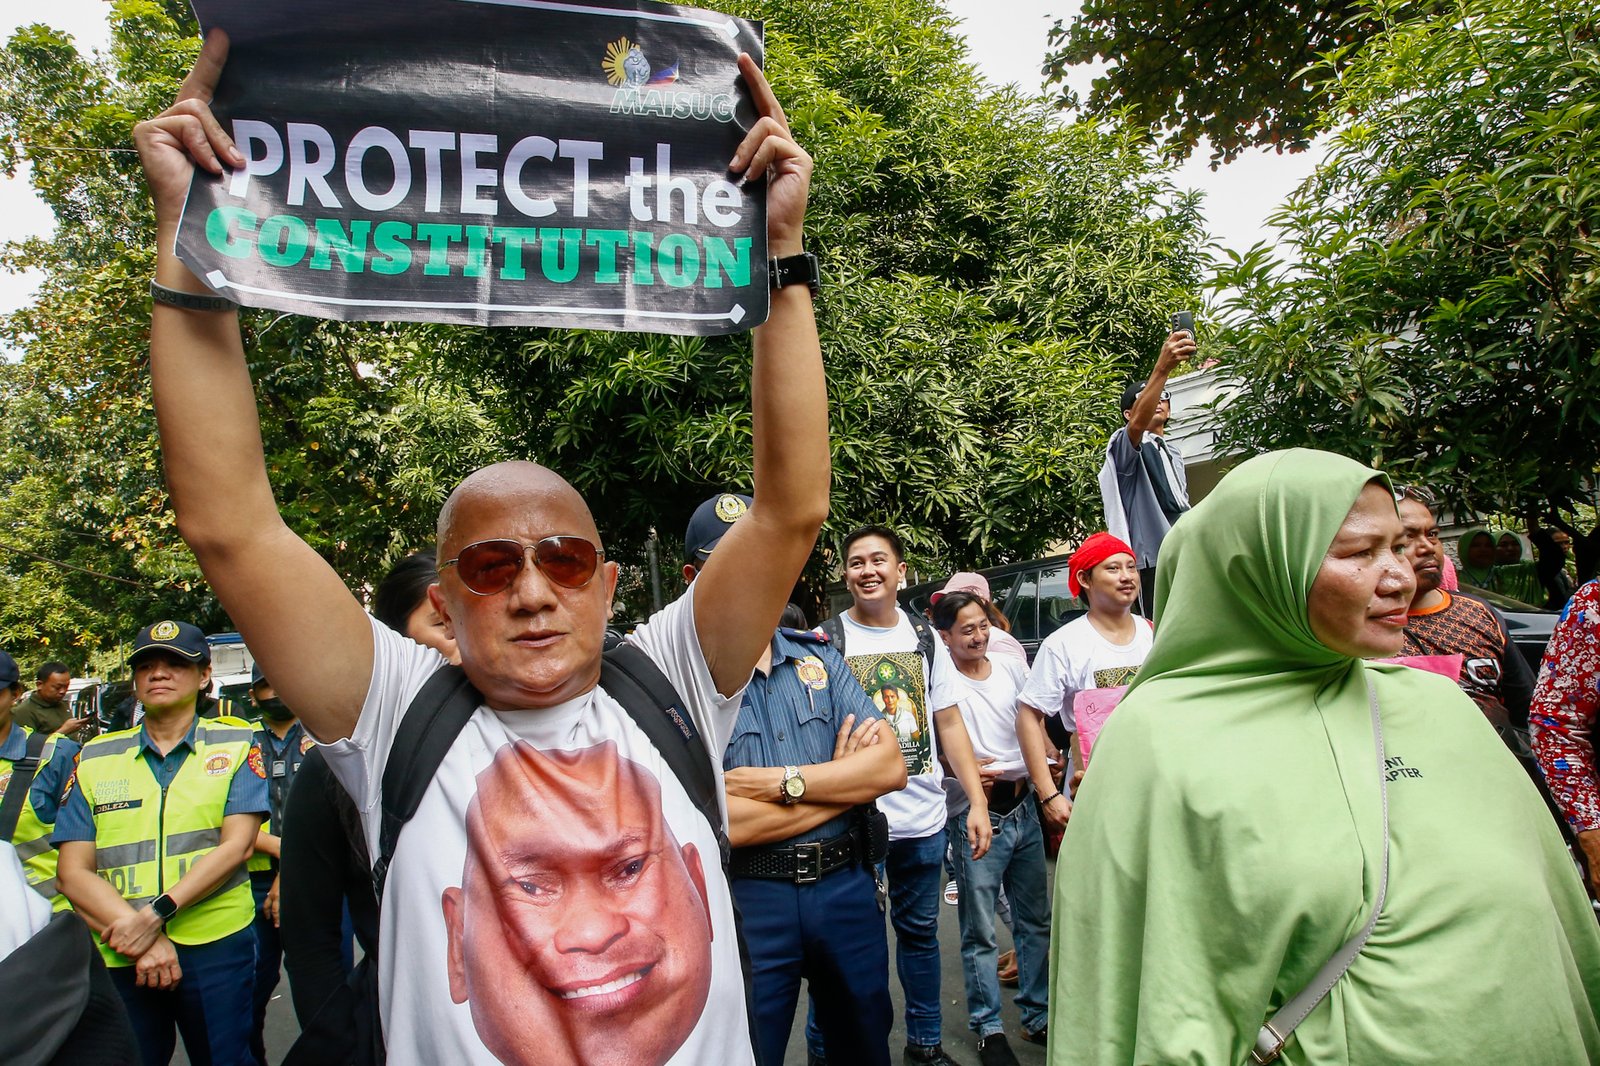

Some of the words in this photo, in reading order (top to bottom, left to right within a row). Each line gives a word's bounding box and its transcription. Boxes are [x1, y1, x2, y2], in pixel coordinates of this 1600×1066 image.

[609, 88, 736, 123] MAISUG
[229, 119, 604, 217] PROTECT
[624, 143, 743, 228] the
[205, 206, 752, 288] CONSTITUTION
[95, 786, 129, 797] RIGHTS
[97, 779, 129, 789] HUMAN
